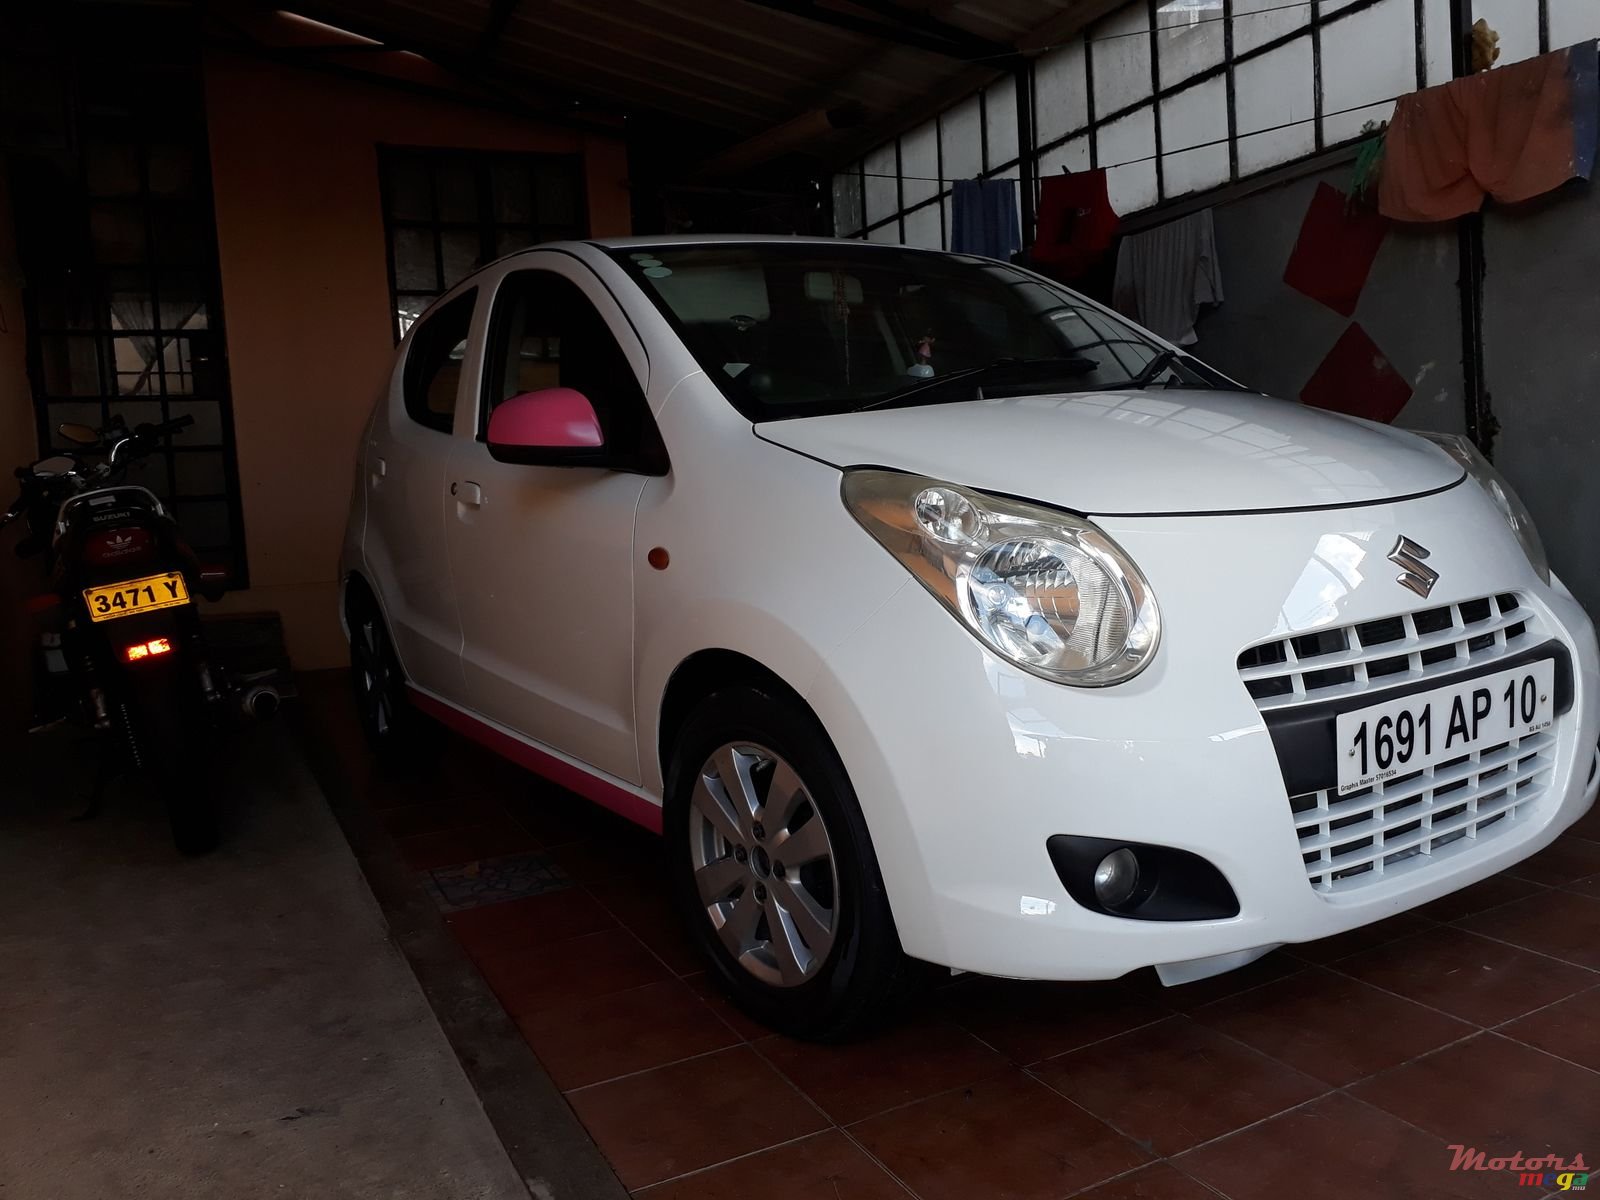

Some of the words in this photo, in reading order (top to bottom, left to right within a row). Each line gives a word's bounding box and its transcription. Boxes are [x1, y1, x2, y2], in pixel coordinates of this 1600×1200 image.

[92, 511, 131, 522] SUZUKI
[101, 545, 142, 559] adidas
[94, 584, 156, 613] 3471
[163, 580, 178, 599] Y
[1353, 703, 1431, 775] 1691
[1445, 688, 1492, 749] AP
[1503, 674, 1537, 729] 10
[1359, 777, 1375, 786] Master
